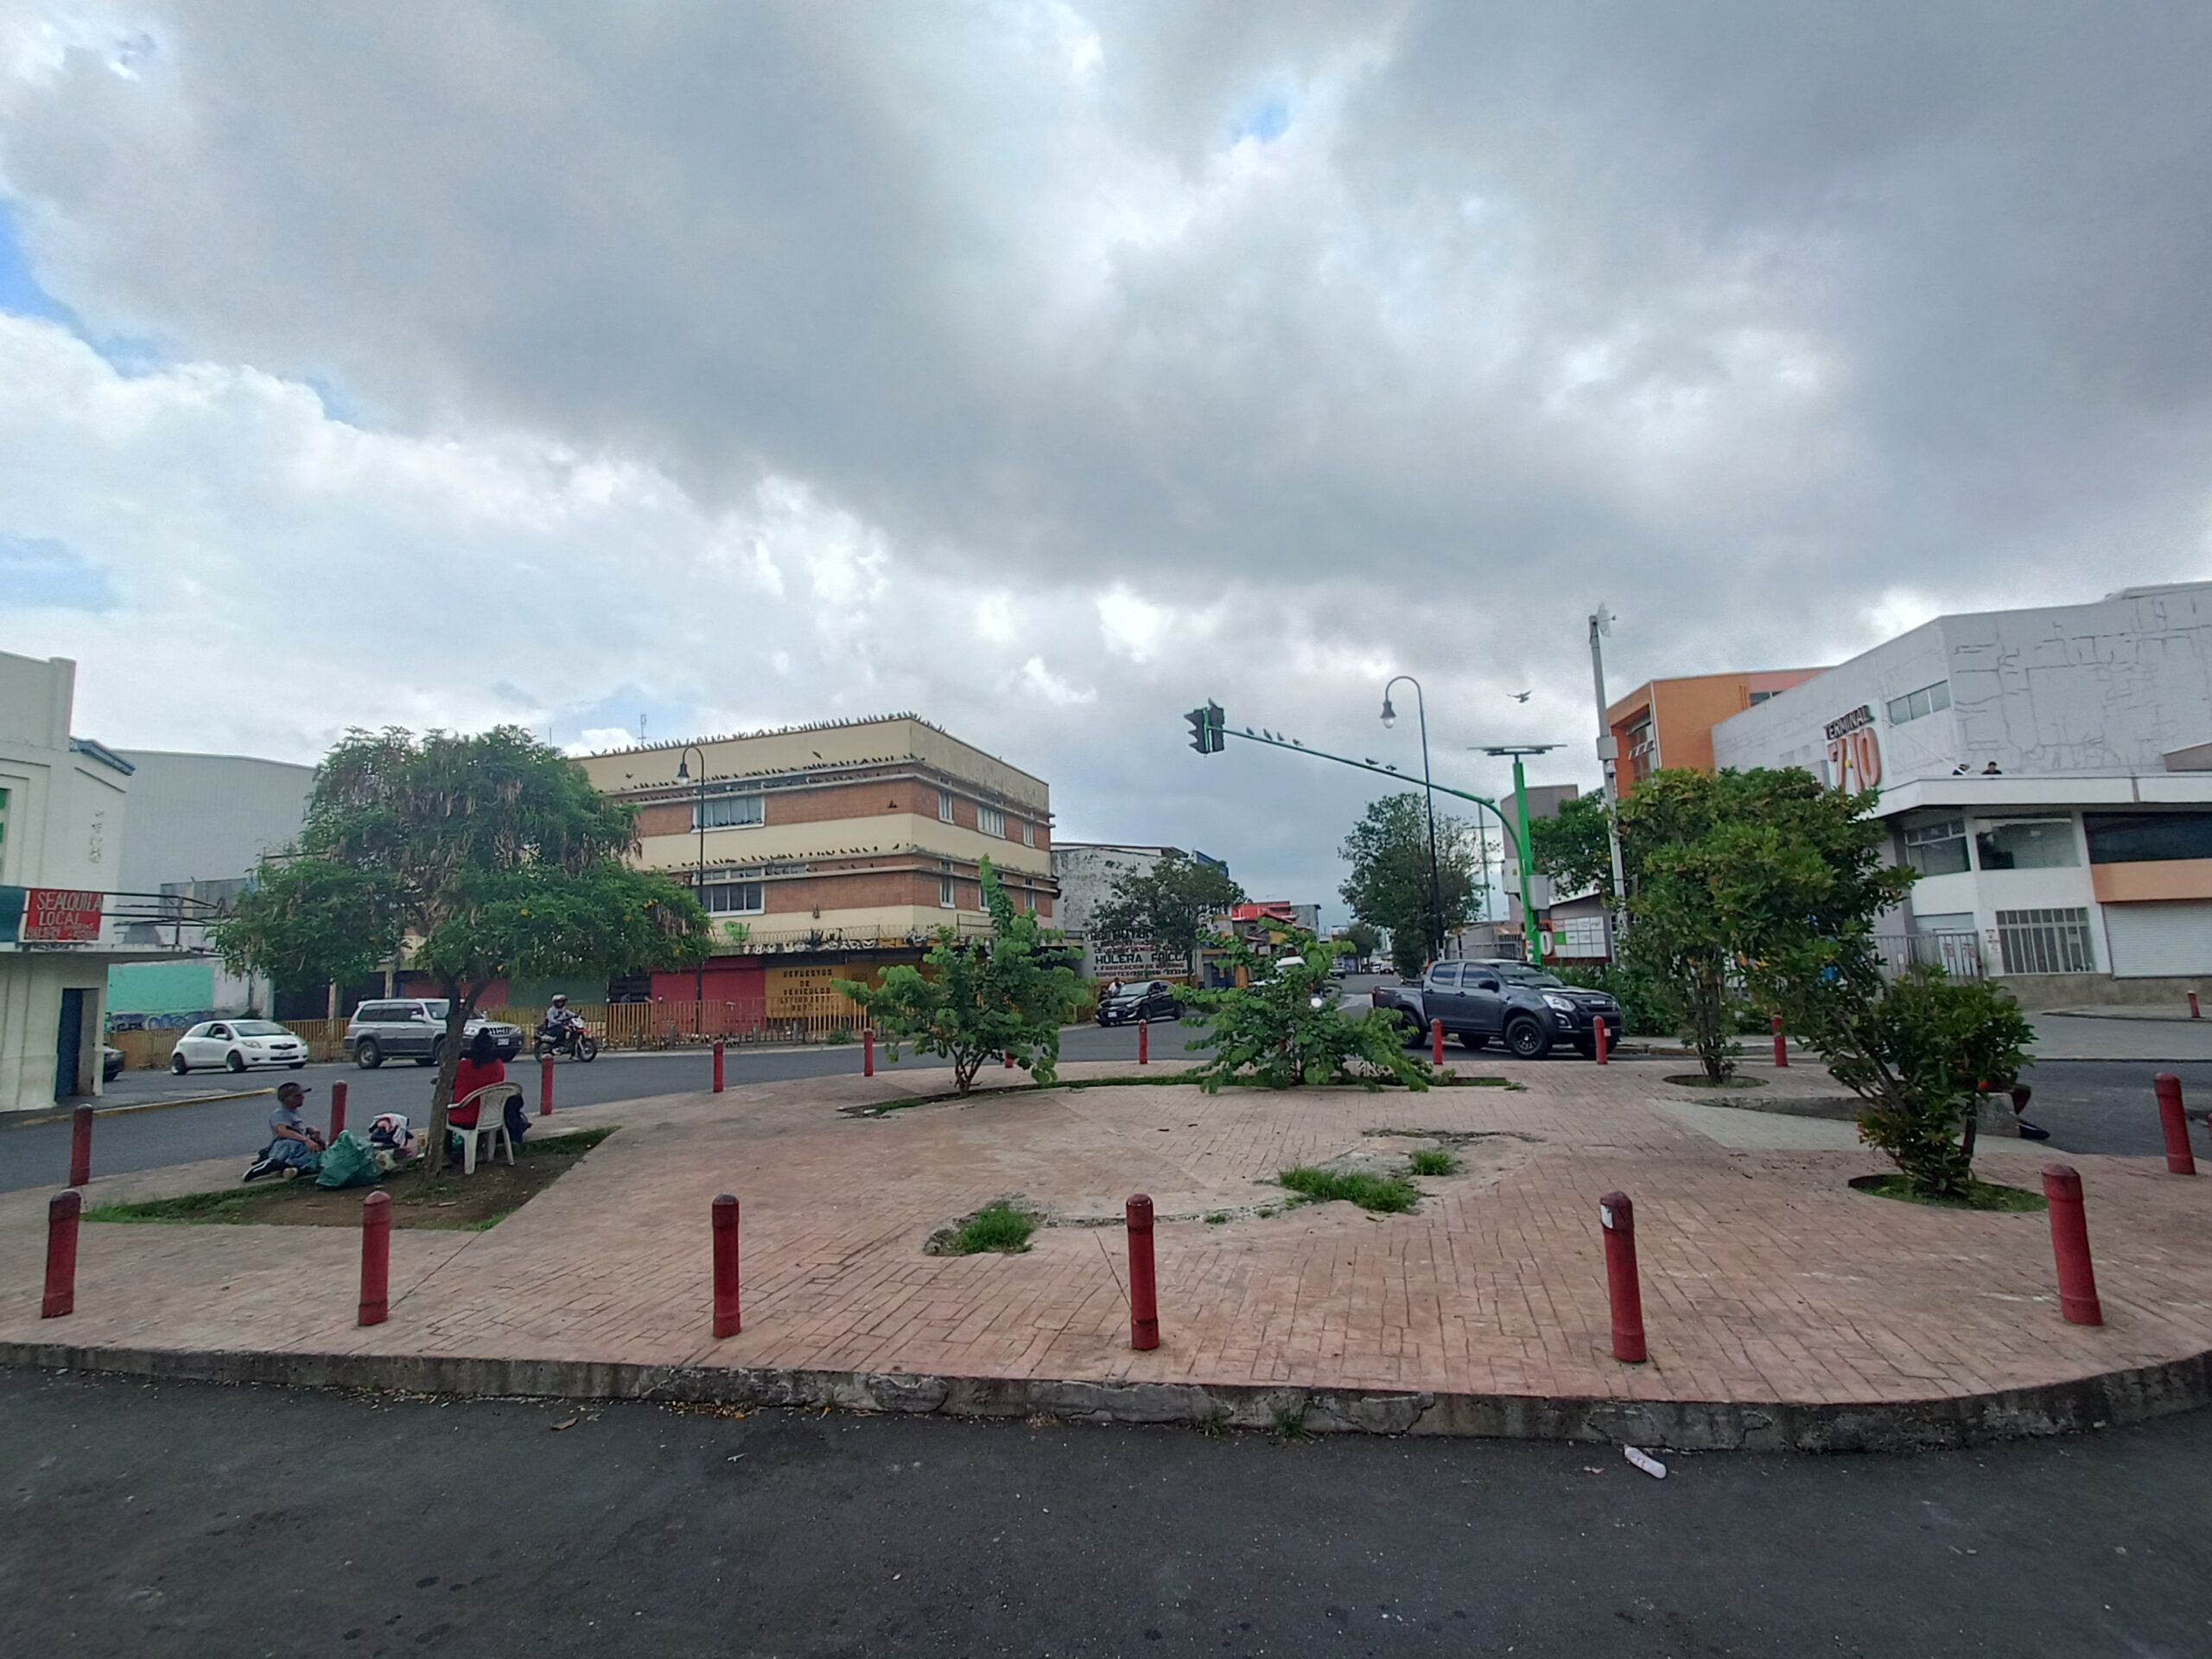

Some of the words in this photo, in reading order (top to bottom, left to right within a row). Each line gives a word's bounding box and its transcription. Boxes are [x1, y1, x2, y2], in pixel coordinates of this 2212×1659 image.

[1823, 705, 1874, 740] TERMINAL
[39, 911, 80, 927] LOCAL
[1095, 953, 1143, 964] HULERA
